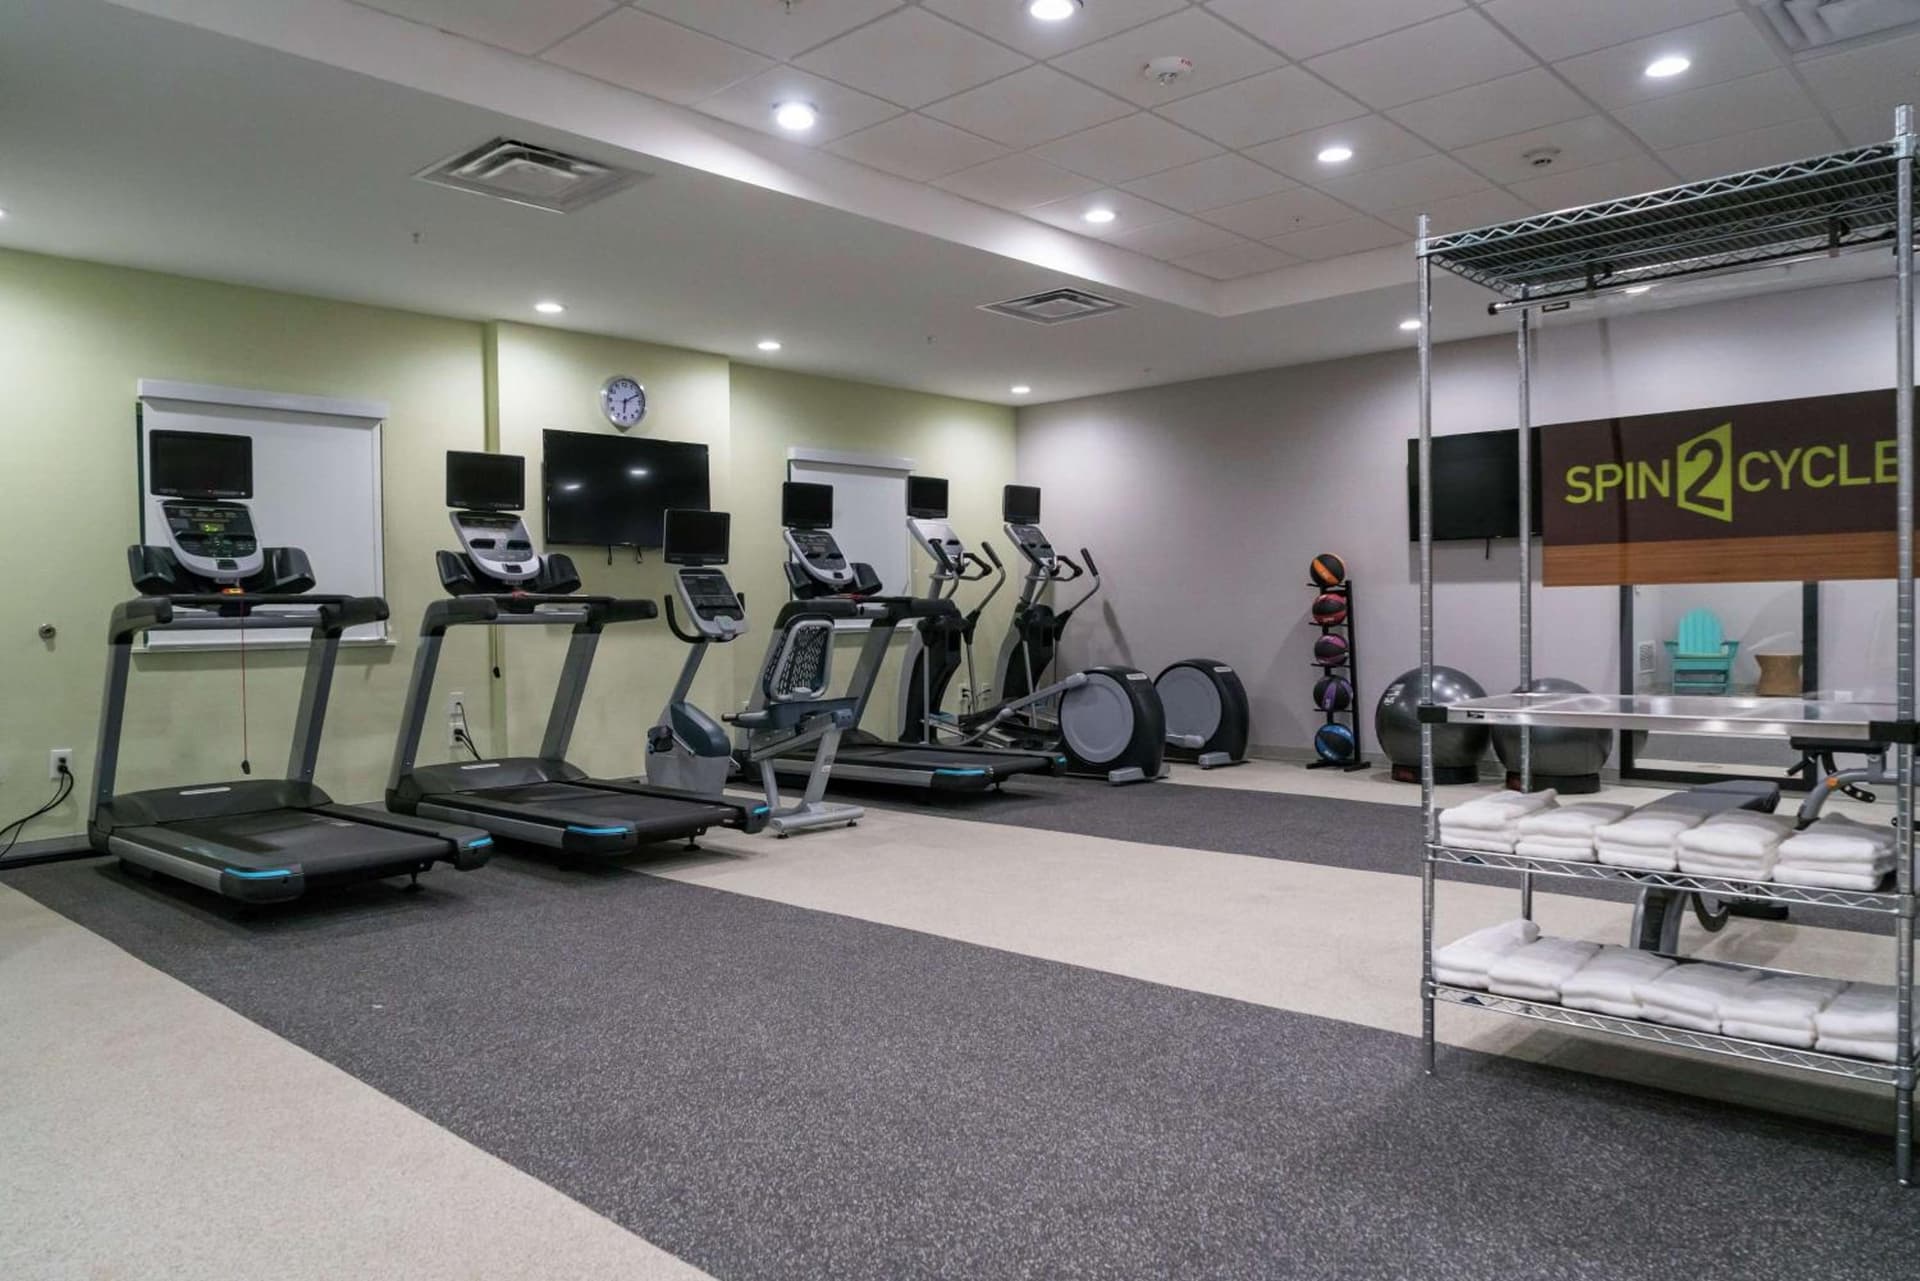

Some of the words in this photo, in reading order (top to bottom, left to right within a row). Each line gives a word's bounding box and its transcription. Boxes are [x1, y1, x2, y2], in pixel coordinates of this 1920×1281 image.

[1565, 460, 1670, 504] SPIN
[1684, 439, 1725, 512] 2
[1738, 440, 1898, 492] CYCLE
